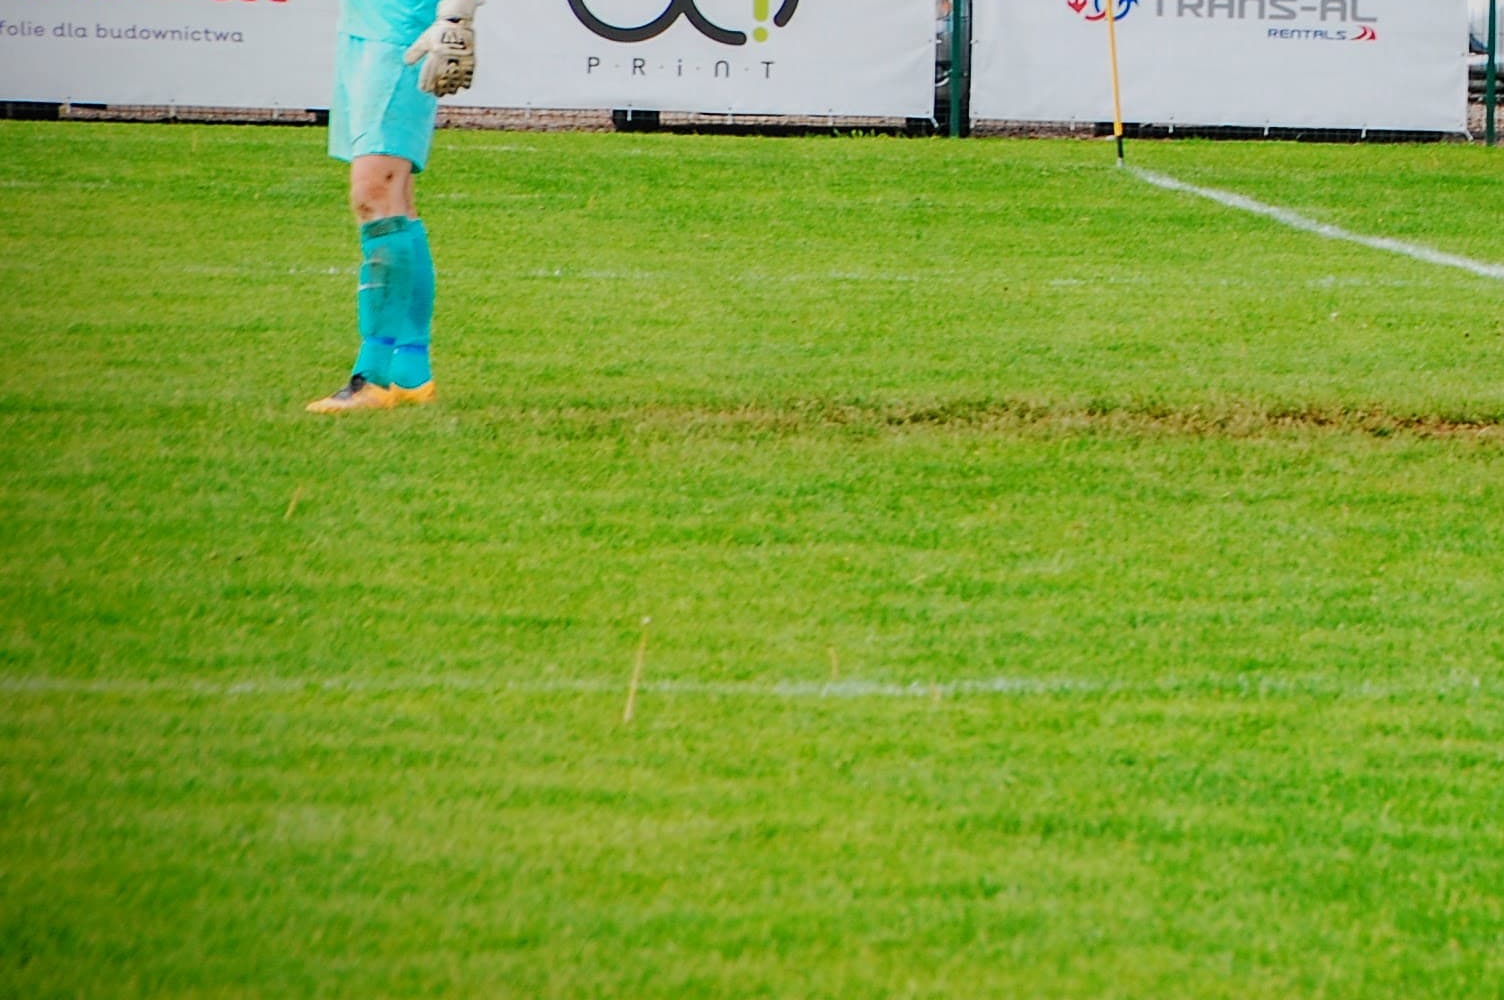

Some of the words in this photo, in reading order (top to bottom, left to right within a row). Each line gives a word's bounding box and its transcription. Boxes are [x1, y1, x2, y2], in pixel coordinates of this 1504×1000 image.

[0, 20, 45, 37] folie
[52, 22, 88, 38] dla
[95, 23, 244, 43] budownictwa
[1267, 27, 1347, 41] RENTALS
